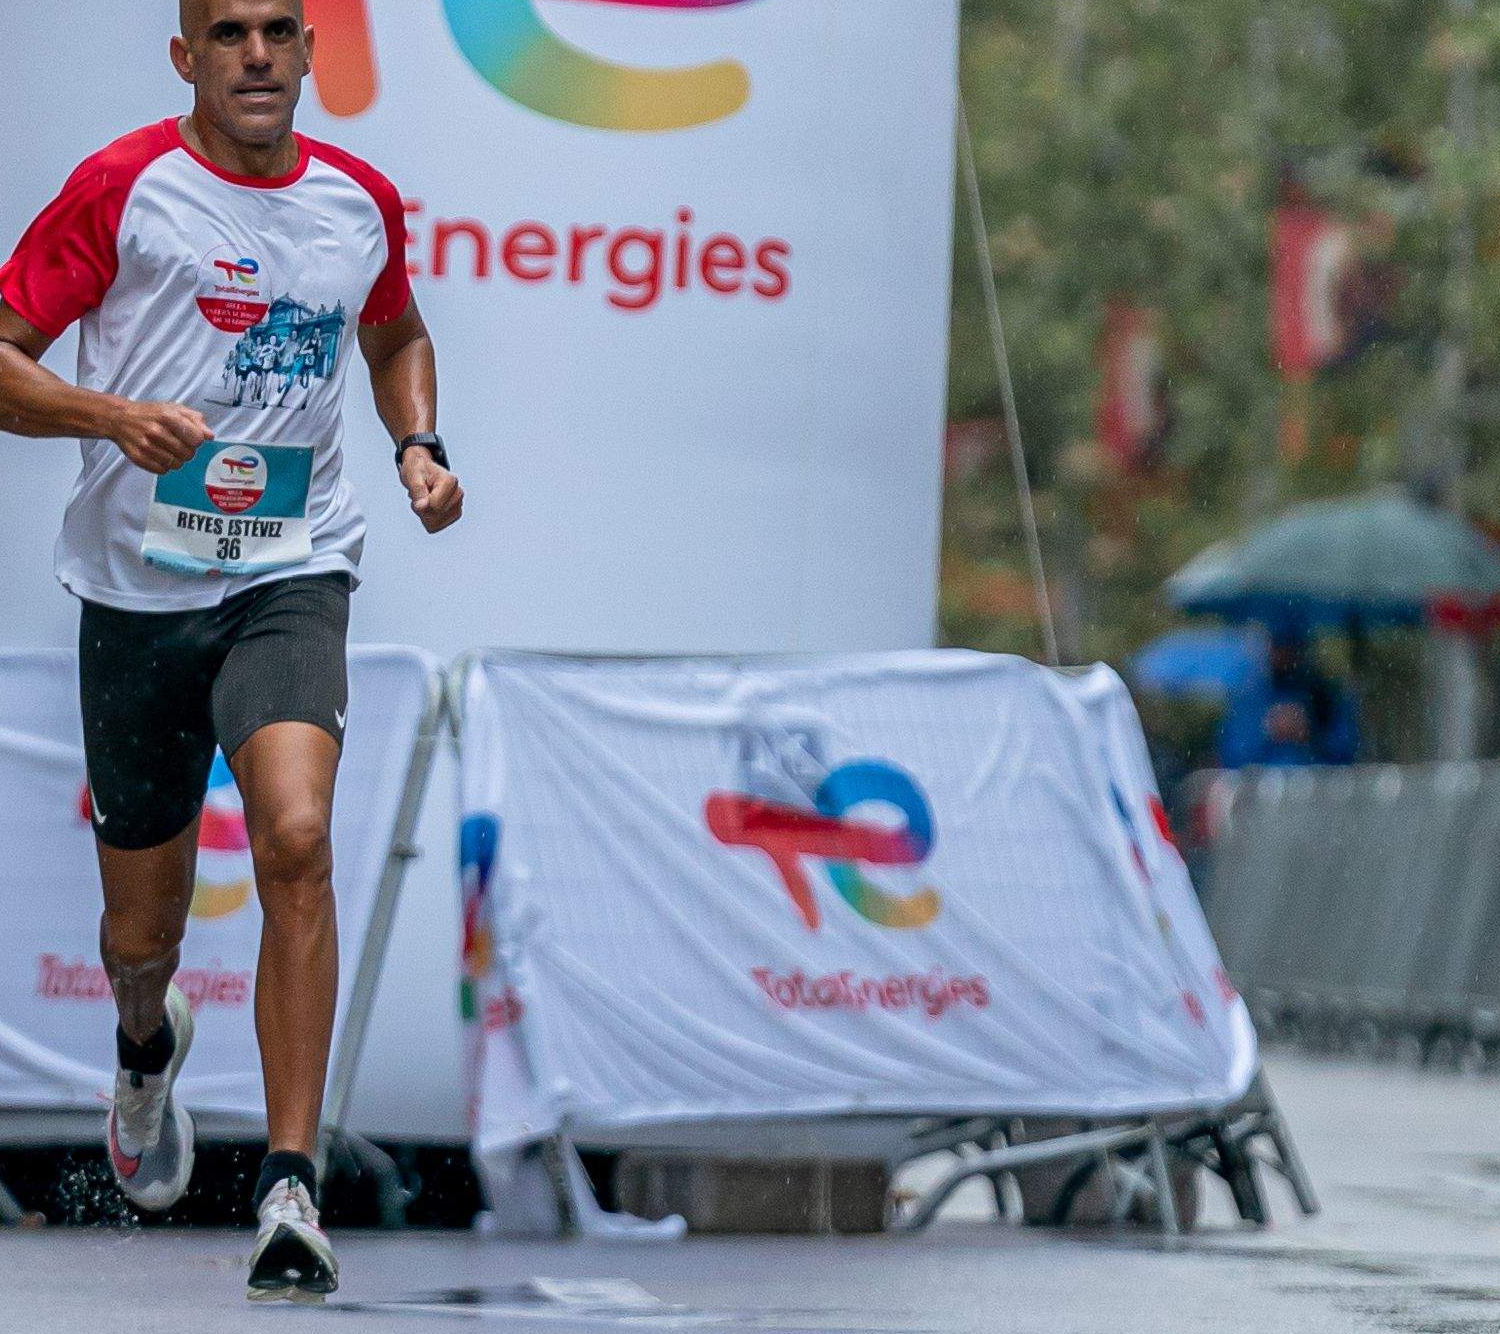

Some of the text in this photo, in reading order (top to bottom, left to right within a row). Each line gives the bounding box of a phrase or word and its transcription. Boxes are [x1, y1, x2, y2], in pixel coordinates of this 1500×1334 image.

[177, 510, 283, 537] REYES ESTÉVEZ
[216, 538, 242, 560] 36
